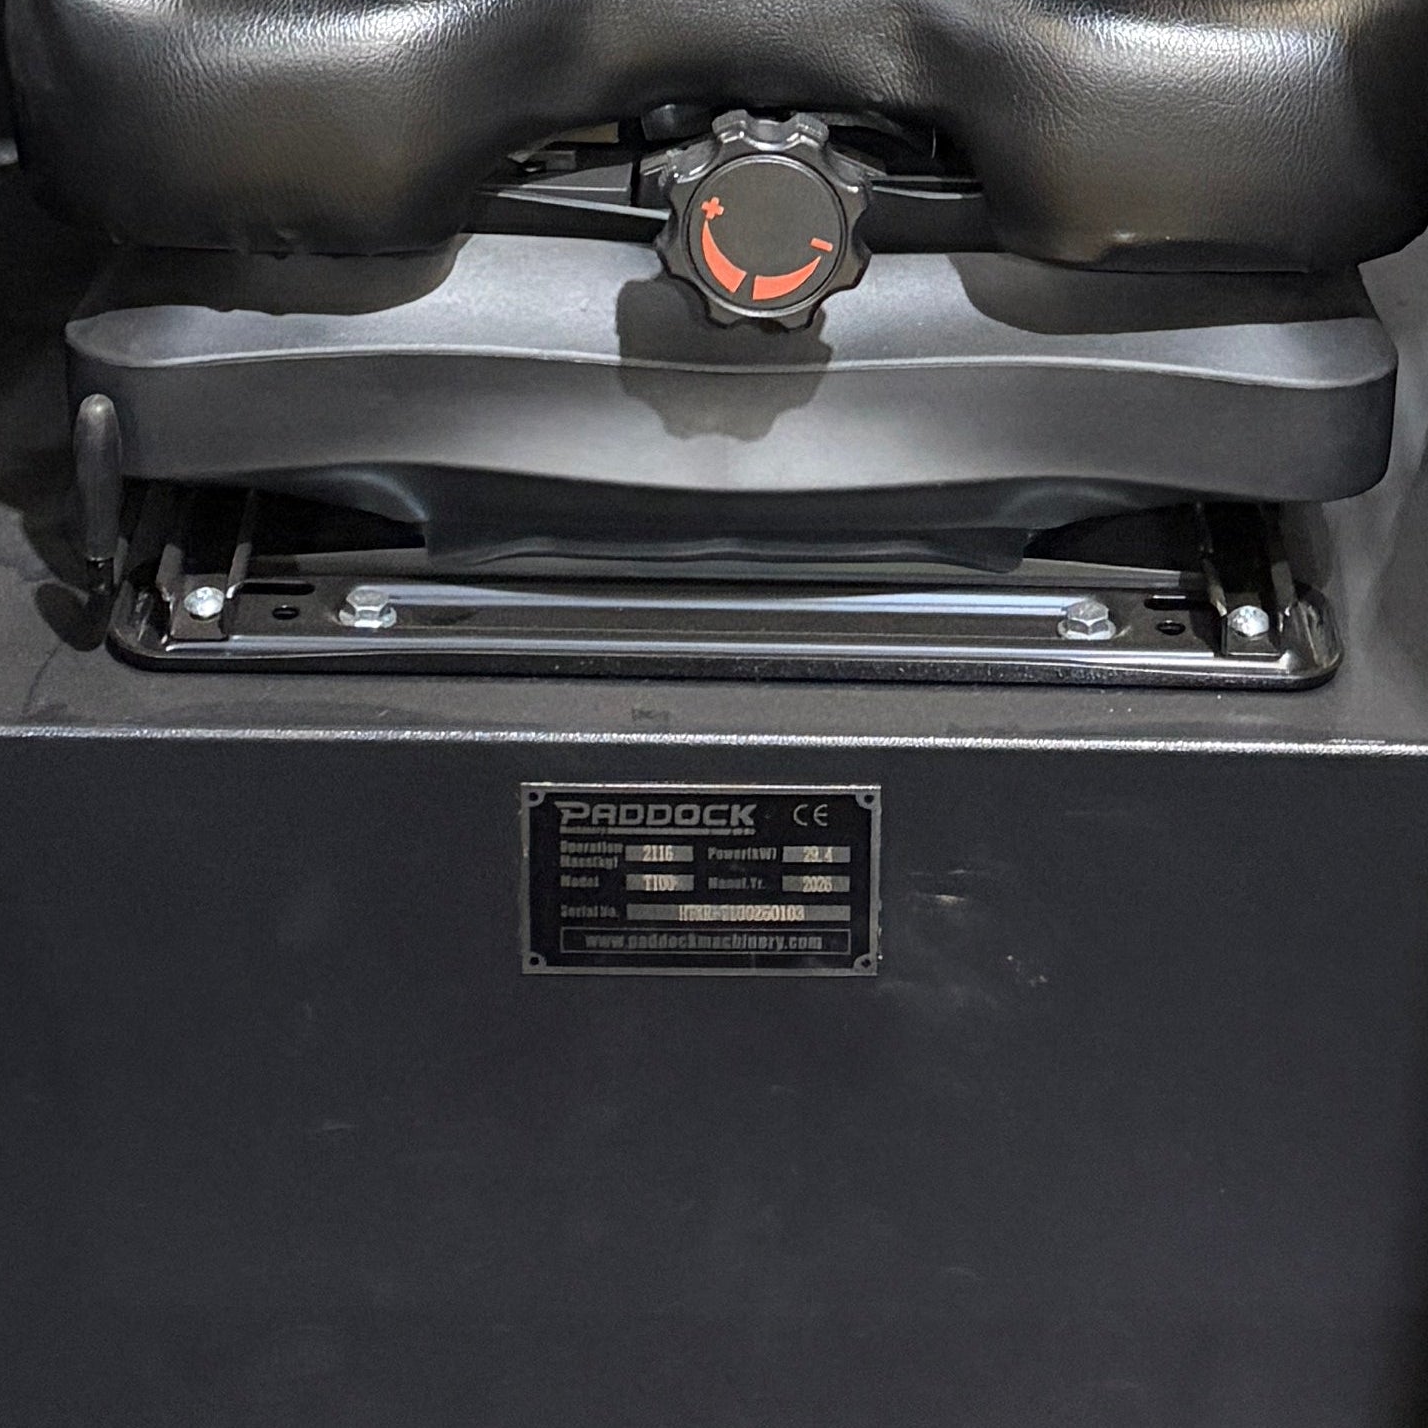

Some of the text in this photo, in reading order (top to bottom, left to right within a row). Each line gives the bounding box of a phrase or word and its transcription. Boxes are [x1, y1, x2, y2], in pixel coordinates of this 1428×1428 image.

[554, 800, 757, 827] PADDOCK
[793, 803, 829, 827] CE
[642, 844, 674, 862] 2116
[707, 847, 777, 861] Power(kW)
[560, 874, 599, 888] Model
[560, 904, 598, 918] Serial
[585, 932, 823, 952] www.paddockmachinery.com
